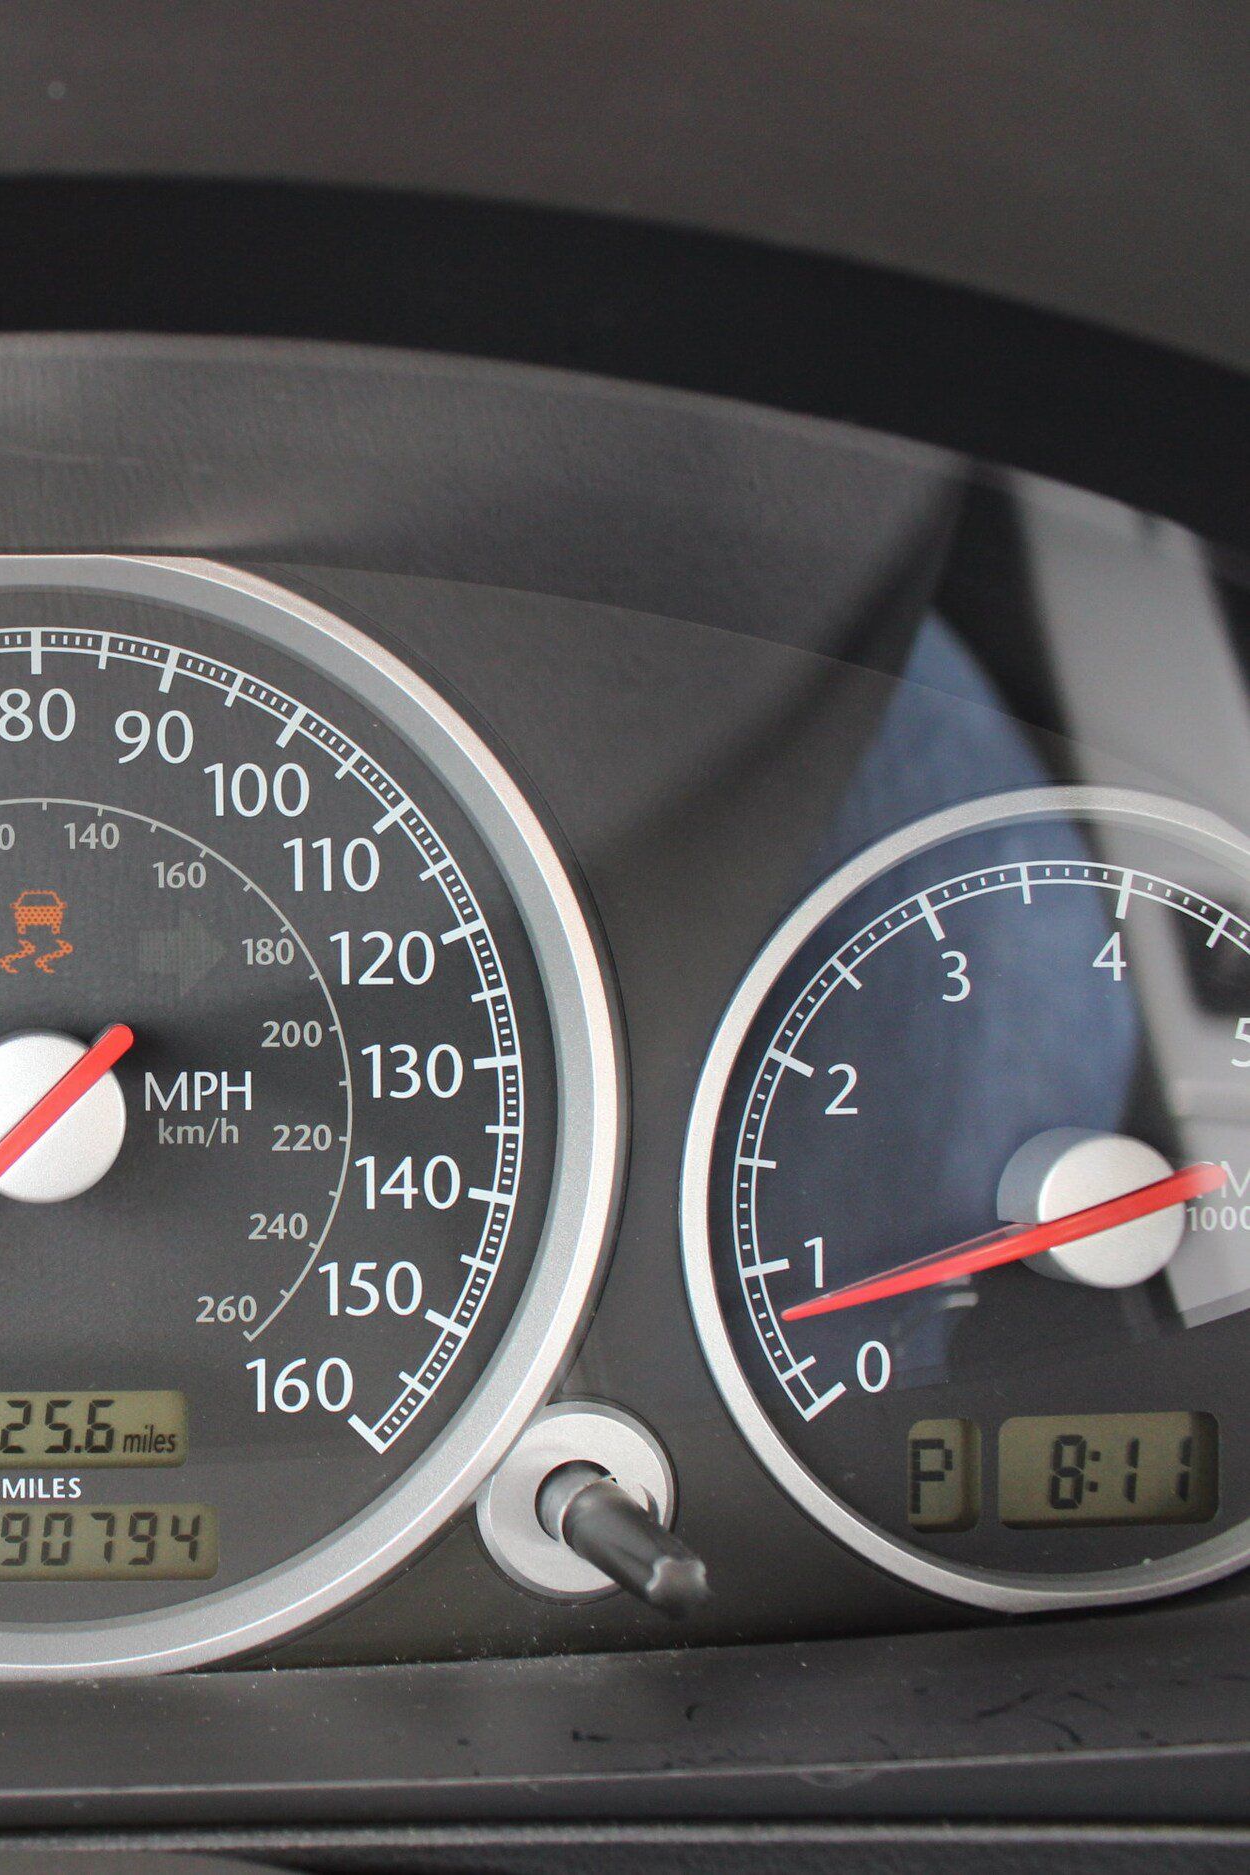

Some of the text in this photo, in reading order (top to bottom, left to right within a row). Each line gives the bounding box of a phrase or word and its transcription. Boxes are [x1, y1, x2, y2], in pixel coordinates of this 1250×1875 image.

[115, 710, 193, 763] 90
[204, 763, 309, 817] 100
[64, 823, 119, 849] 140
[153, 862, 206, 888] 160
[283, 838, 379, 891] 110
[242, 938, 295, 965] 180
[330, 931, 434, 985] 120
[941, 951, 970, 1001] 3
[1093, 932, 1126, 981] 4
[262, 1021, 322, 1047] 200
[145, 1071, 251, 1111] MPH
[362, 1044, 463, 1098] 130
[825, 1064, 857, 1114] 2
[159, 1118, 238, 1147] km/h
[272, 1125, 332, 1151] 220
[355, 1155, 460, 1209] 140
[249, 1213, 308, 1239] 240
[804, 1237, 823, 1288] 1
[196, 1295, 257, 1322] 260
[319, 1261, 422, 1316] 150
[246, 1358, 353, 1412] 160
[857, 1341, 890, 1392] 0
[122, 1424, 177, 1454] miles
[3, 1478, 81, 1498] MILES
[911, 1438, 954, 1515] P
[1050, 1434, 1193, 1510] 8:11
